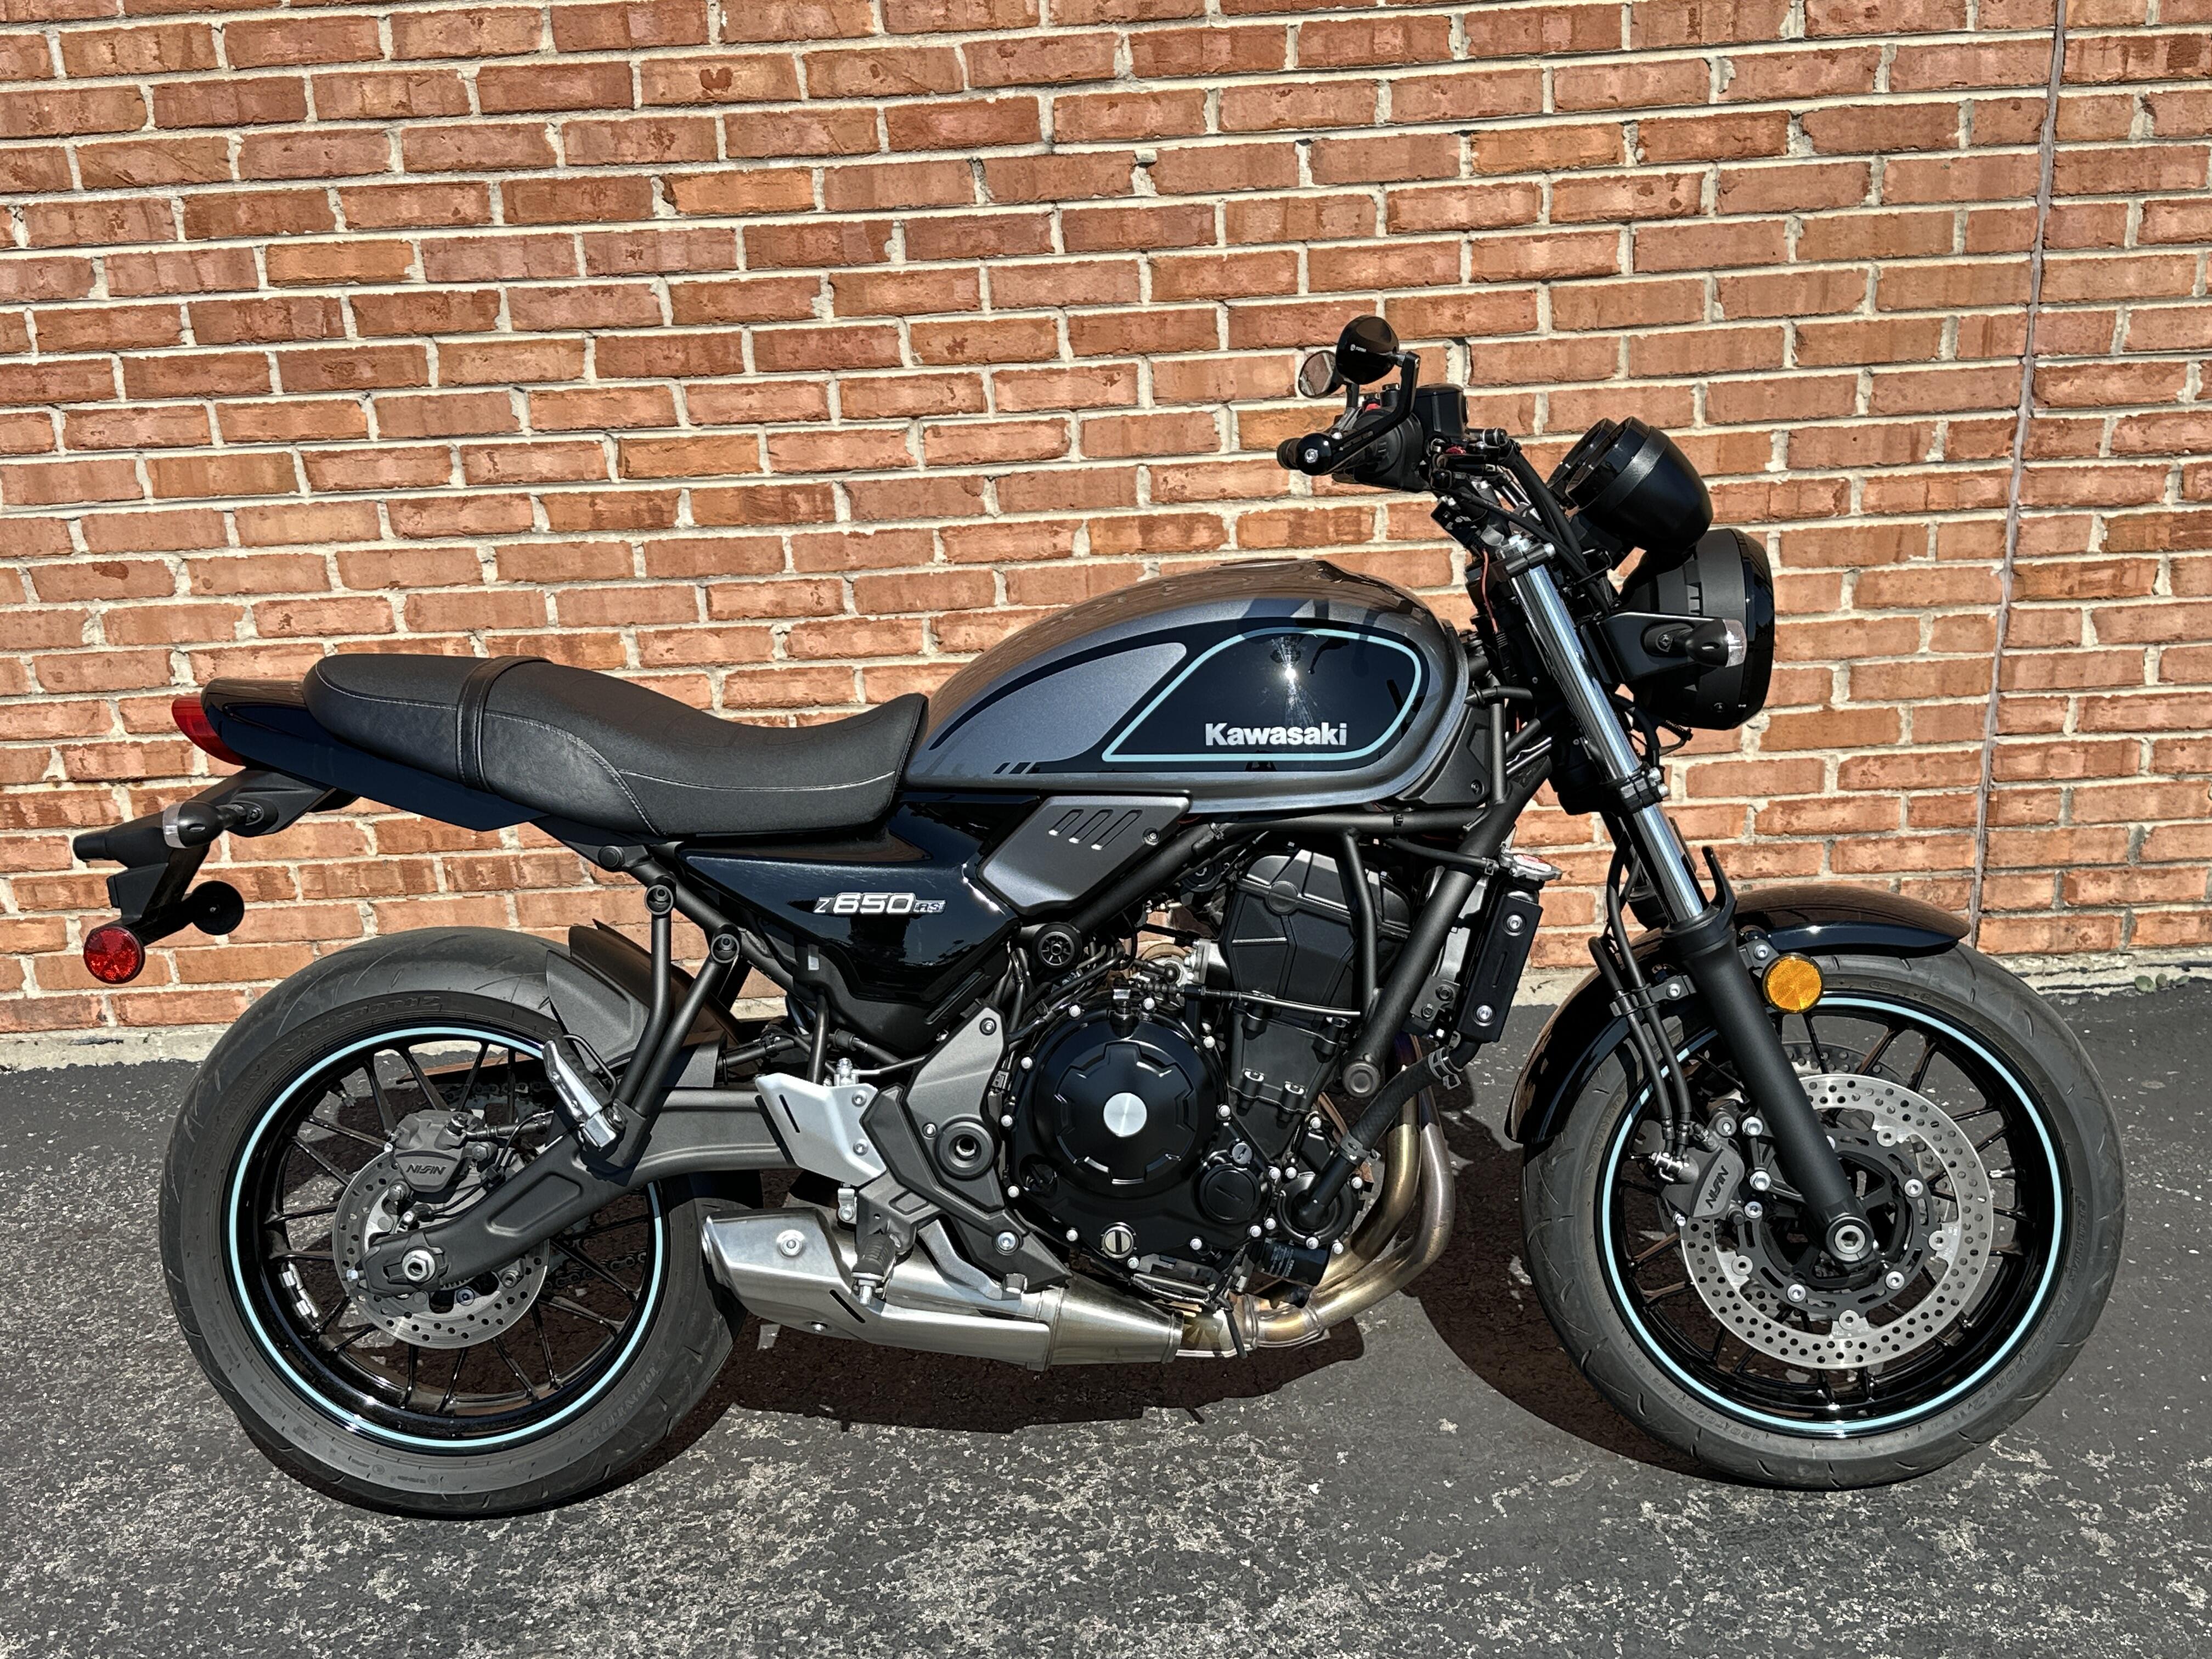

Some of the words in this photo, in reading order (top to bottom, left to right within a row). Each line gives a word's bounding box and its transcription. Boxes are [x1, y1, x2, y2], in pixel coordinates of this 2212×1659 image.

[1205, 722, 1347, 746] Kawasaki
[405, 1164, 447, 1175] NISSIN
[1705, 1165, 1729, 1209] NISSIN
